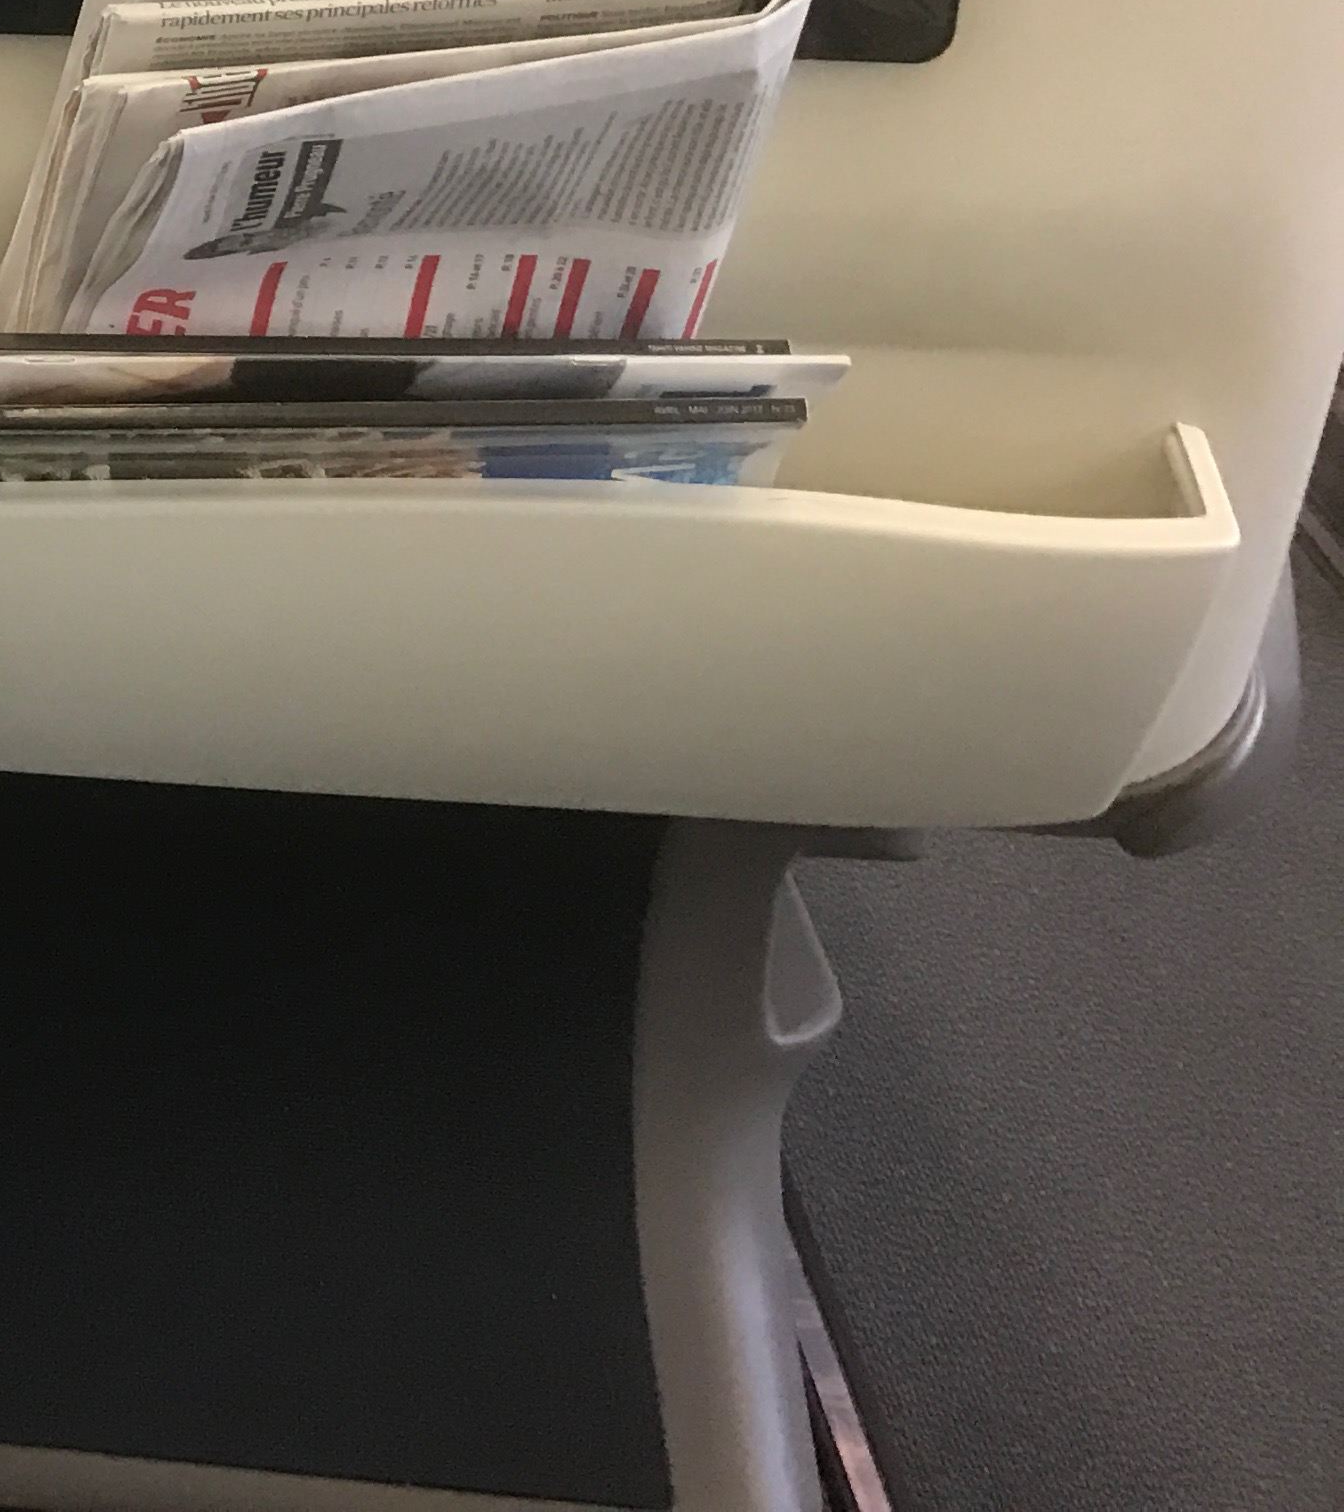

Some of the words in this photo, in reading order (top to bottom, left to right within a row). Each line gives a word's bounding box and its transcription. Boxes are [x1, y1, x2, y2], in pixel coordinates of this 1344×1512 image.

[161, 7, 271, 30] rapidement
[275, 7, 305, 21] ses
[229, 150, 288, 232] l'humeur
